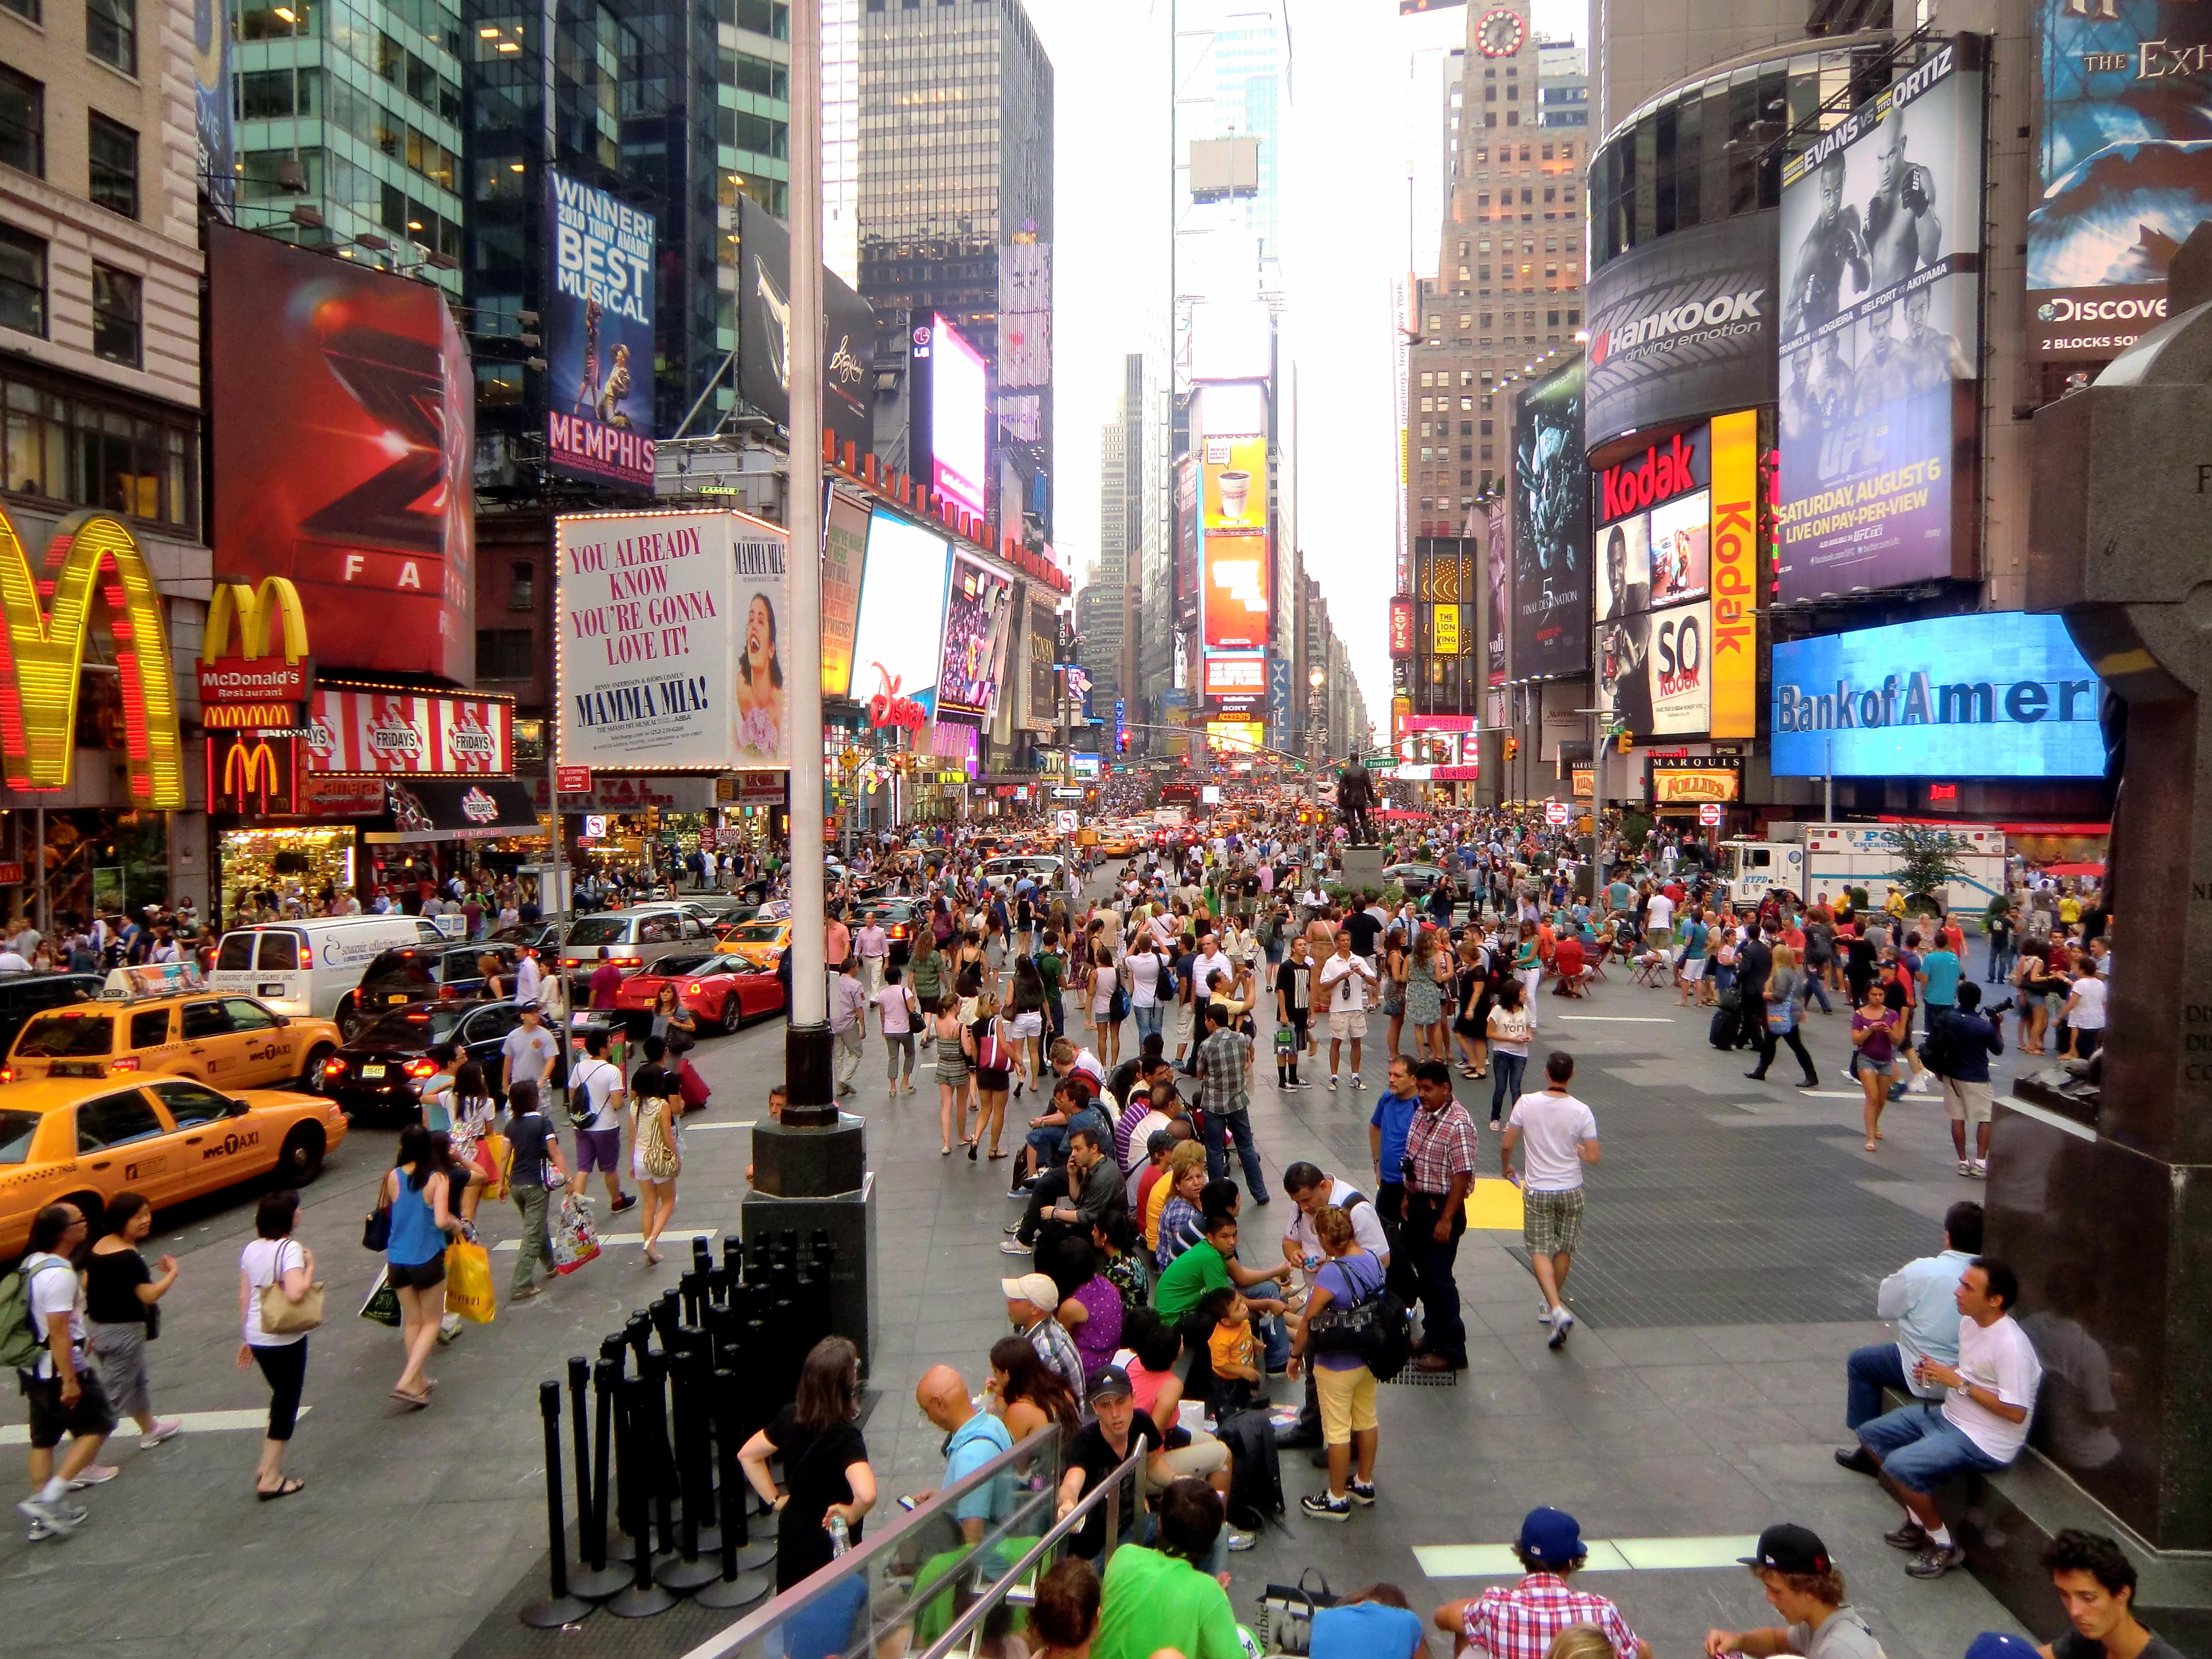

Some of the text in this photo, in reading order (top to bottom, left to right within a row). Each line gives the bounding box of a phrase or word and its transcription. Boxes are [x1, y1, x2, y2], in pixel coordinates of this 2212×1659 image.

[2084, 54, 2126, 72] THE
[1803, 115, 1858, 172] EVANS
[1860, 108, 1874, 129] VS
[1877, 97, 1891, 113] TITO
[1892, 46, 1953, 103] ORTIZ
[551, 170, 653, 243] WINNER!
[558, 205, 649, 258] 2010 TONY AWARD
[558, 224, 649, 299] BEST
[558, 265, 649, 325] MUSICAL
[1861, 264, 1947, 315] BELFORT AKIYAMA
[1625, 321, 1762, 363] driving emotion
[1779, 311, 1854, 355] FRANKLIN NOGUEIRA
[2042, 336, 2110, 350] 2 BLOCKS
[549, 411, 655, 475] MEMPHIS
[1603, 434, 1695, 522] Kodak
[1779, 483, 1854, 525] SATURDAY,
[1856, 462, 1924, 503] AUGUST
[1928, 457, 1941, 481] 6
[1786, 488, 1928, 544] LIVE ON PAY-PER-VIEW
[569, 526, 701, 575] YOU ALREADY
[733, 542, 785, 574] MAMMA MIA!
[345, 555, 420, 588] F A
[609, 564, 669, 601] KNOW
[1715, 500, 1751, 656] Kodak
[570, 589, 717, 639] YOU'RE GONNA
[1523, 590, 1578, 616] FINAL DESTINATION
[606, 625, 689, 666] LOVE IT!
[1394, 607, 1407, 648] Levi's
[1437, 622, 1455, 633] LION
[1437, 635, 1456, 647] KING
[1489, 633, 1504, 654] voli
[1031, 631, 1054, 663] CONAN
[1657, 615, 1701, 682] SO
[202, 671, 299, 686] McDonald's
[219, 688, 283, 697] Restaurant
[1660, 668, 1700, 697] Kodak
[575, 675, 709, 728] MAMMA MIA!
[870, 662, 926, 751] Disney
[1778, 680, 1861, 733] Bank
[1861, 674, 1902, 728] of
[607, 724, 625, 732] SMASH
[635, 719, 657, 729] MUSICAL
[931, 721, 974, 757] FOREVER
[1432, 766, 1478, 779] AERO
[1653, 758, 1740, 767] MARQUIS
[1666, 777, 1725, 800] FOLLIES
[342, 942, 367, 955] souvenir
[369, 939, 398, 951] collections
[216, 972, 295, 981] souvenir collections inc.
[1503, 1024, 1526, 1033] York
[250, 1043, 291, 1061] NYC TAXI
[203, 1131, 259, 1160] NYC TAXI
